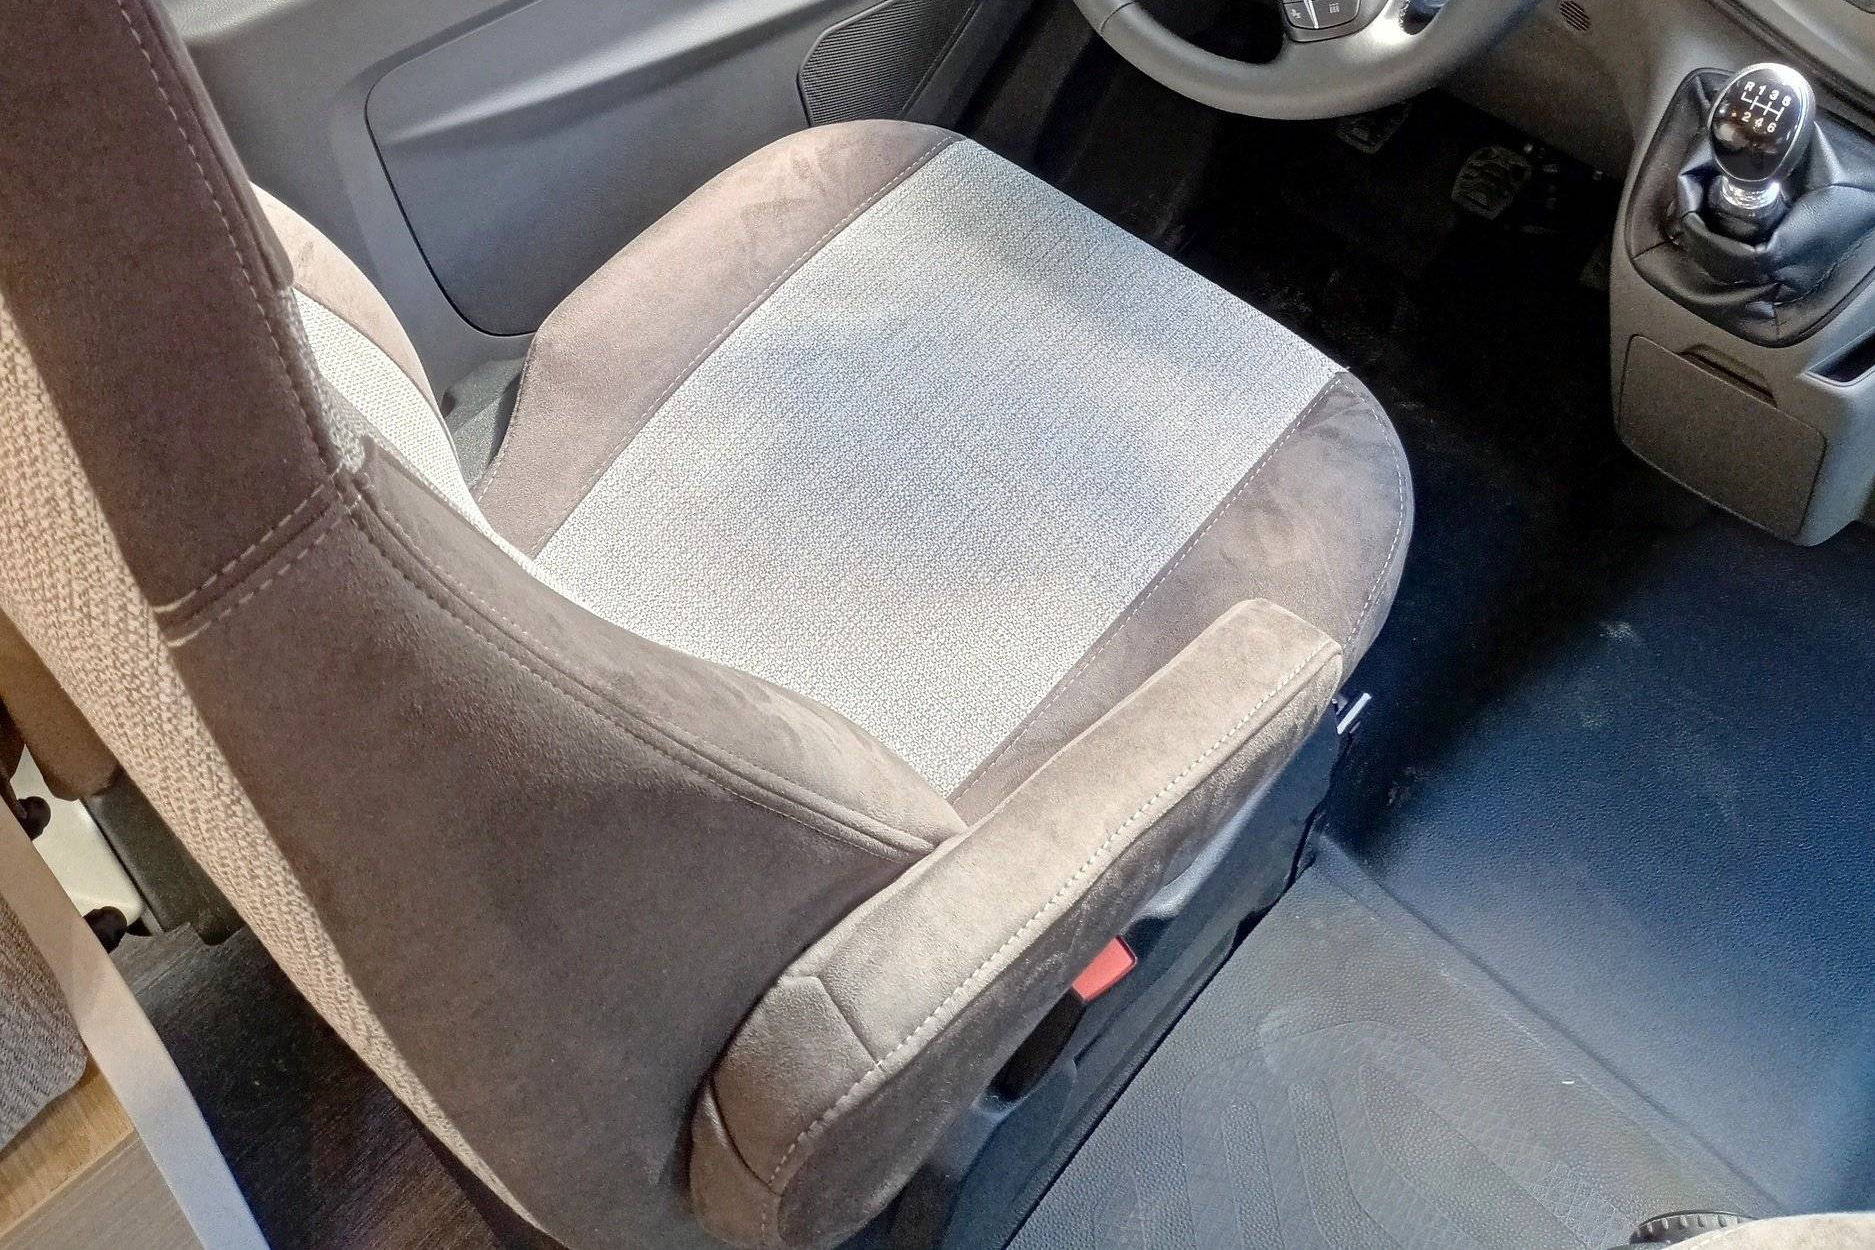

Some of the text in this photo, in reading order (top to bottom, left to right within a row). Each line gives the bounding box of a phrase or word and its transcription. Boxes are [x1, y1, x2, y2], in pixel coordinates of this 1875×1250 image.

[1744, 81, 1756, 92] R
[1758, 85, 1767, 96] 1
[1769, 89, 1780, 101] 3
[1741, 111, 1777, 133] 2 4 6
